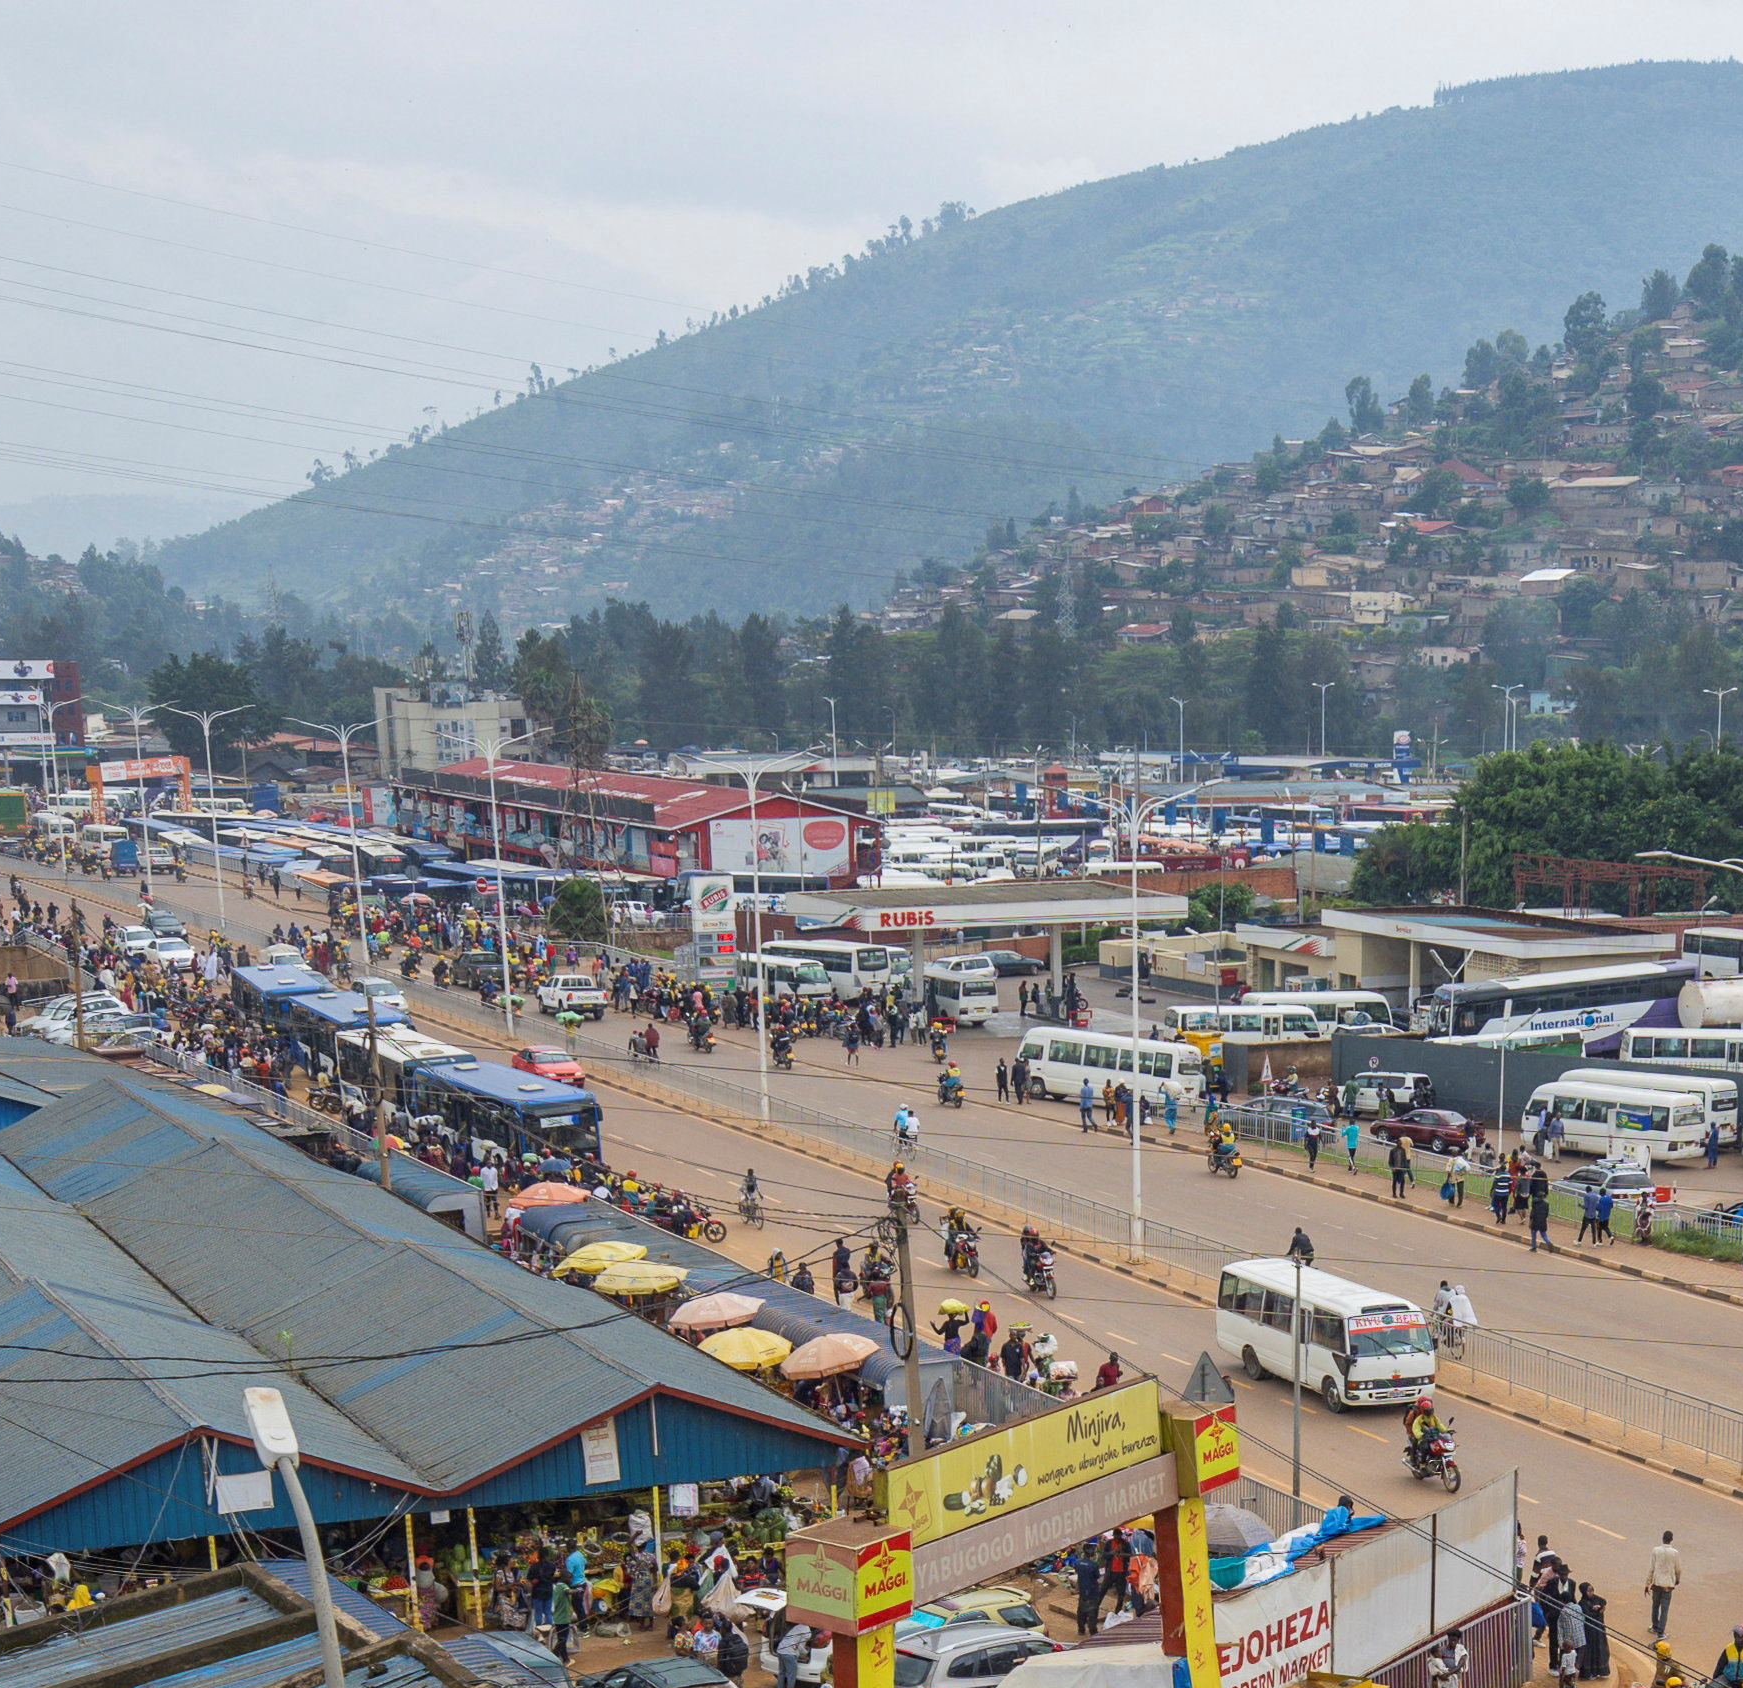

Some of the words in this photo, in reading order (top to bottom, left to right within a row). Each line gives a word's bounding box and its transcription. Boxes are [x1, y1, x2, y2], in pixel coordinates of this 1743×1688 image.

[1354, 1317, 1381, 1328] KIVU
[1066, 1408, 1126, 1446] Minjira,
[1202, 1441, 1235, 1466] MAGGI
[1037, 1463, 1076, 1488] wongere
[913, 1534, 1015, 1587] YABUGOGO
[1024, 1503, 1095, 1543] MODERN
[1104, 1473, 1166, 1519] MARKET
[796, 1576, 849, 1603] MAGGI
[864, 1574, 908, 1600] MAGGI
[1279, 1643, 1331, 1686] MARKET
